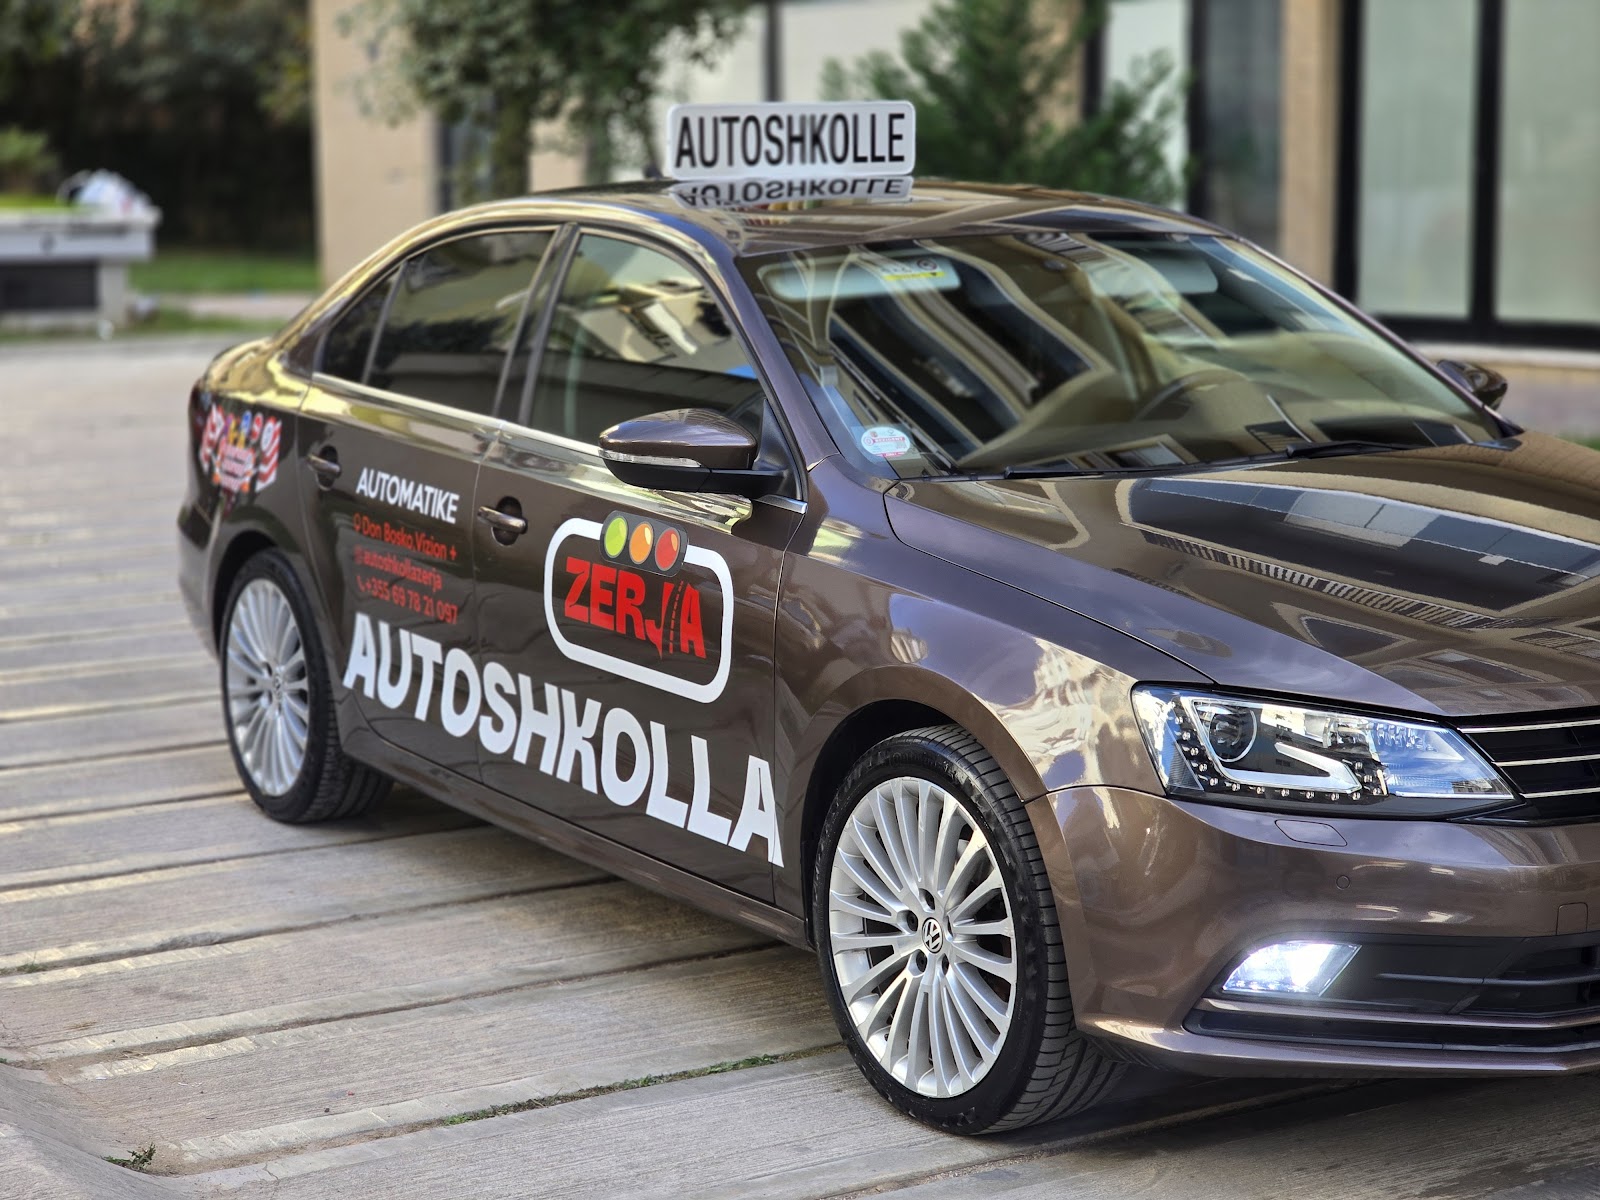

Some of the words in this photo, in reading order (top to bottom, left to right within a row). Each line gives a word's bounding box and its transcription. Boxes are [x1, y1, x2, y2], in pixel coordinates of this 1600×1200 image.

[675, 113, 905, 168] AUTOSHKOLLE
[356, 467, 460, 524] AUTOMATIKE
[362, 515, 382, 538] Don
[366, 577, 390, 601] +355
[392, 584, 406, 607] 69
[408, 590, 421, 612] 78
[423, 596, 434, 617] 21
[436, 600, 459, 624] 097
[564, 557, 706, 659] ZERJA
[342, 612, 785, 868] AUTOSHKOLLA
